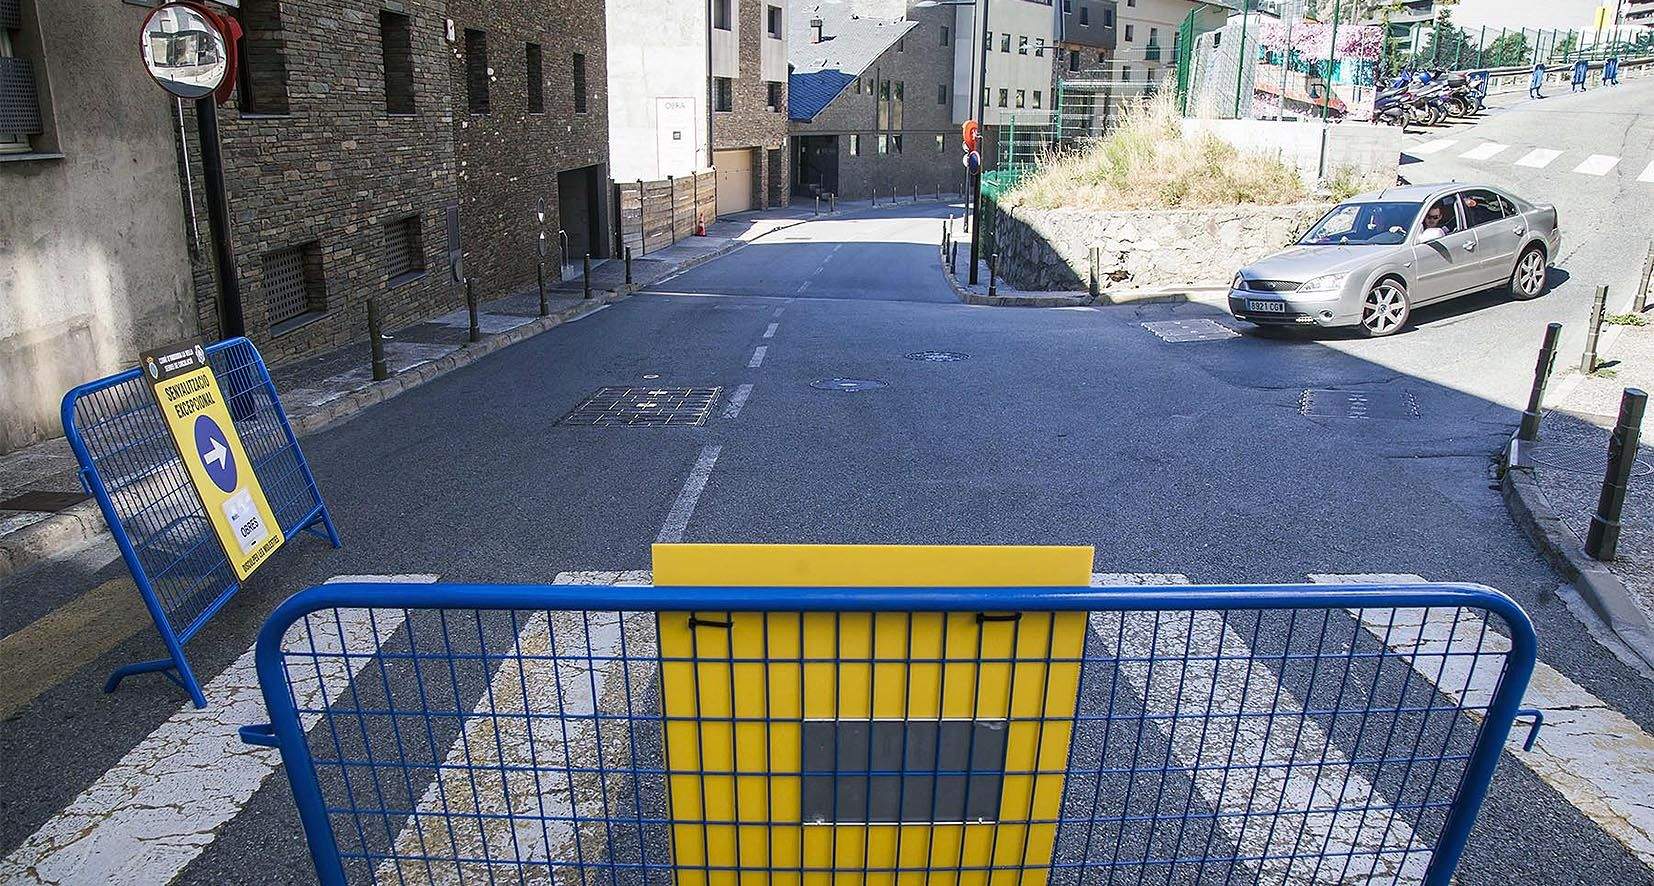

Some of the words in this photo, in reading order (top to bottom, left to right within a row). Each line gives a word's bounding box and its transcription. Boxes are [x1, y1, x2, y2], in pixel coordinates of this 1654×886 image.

[1251, 301, 1268, 311] 8921
[164, 371, 210, 402] SENYALITZACIÓ
[174, 391, 216, 418] EXCEPCIONAL
[240, 516, 259, 538] OBRES
